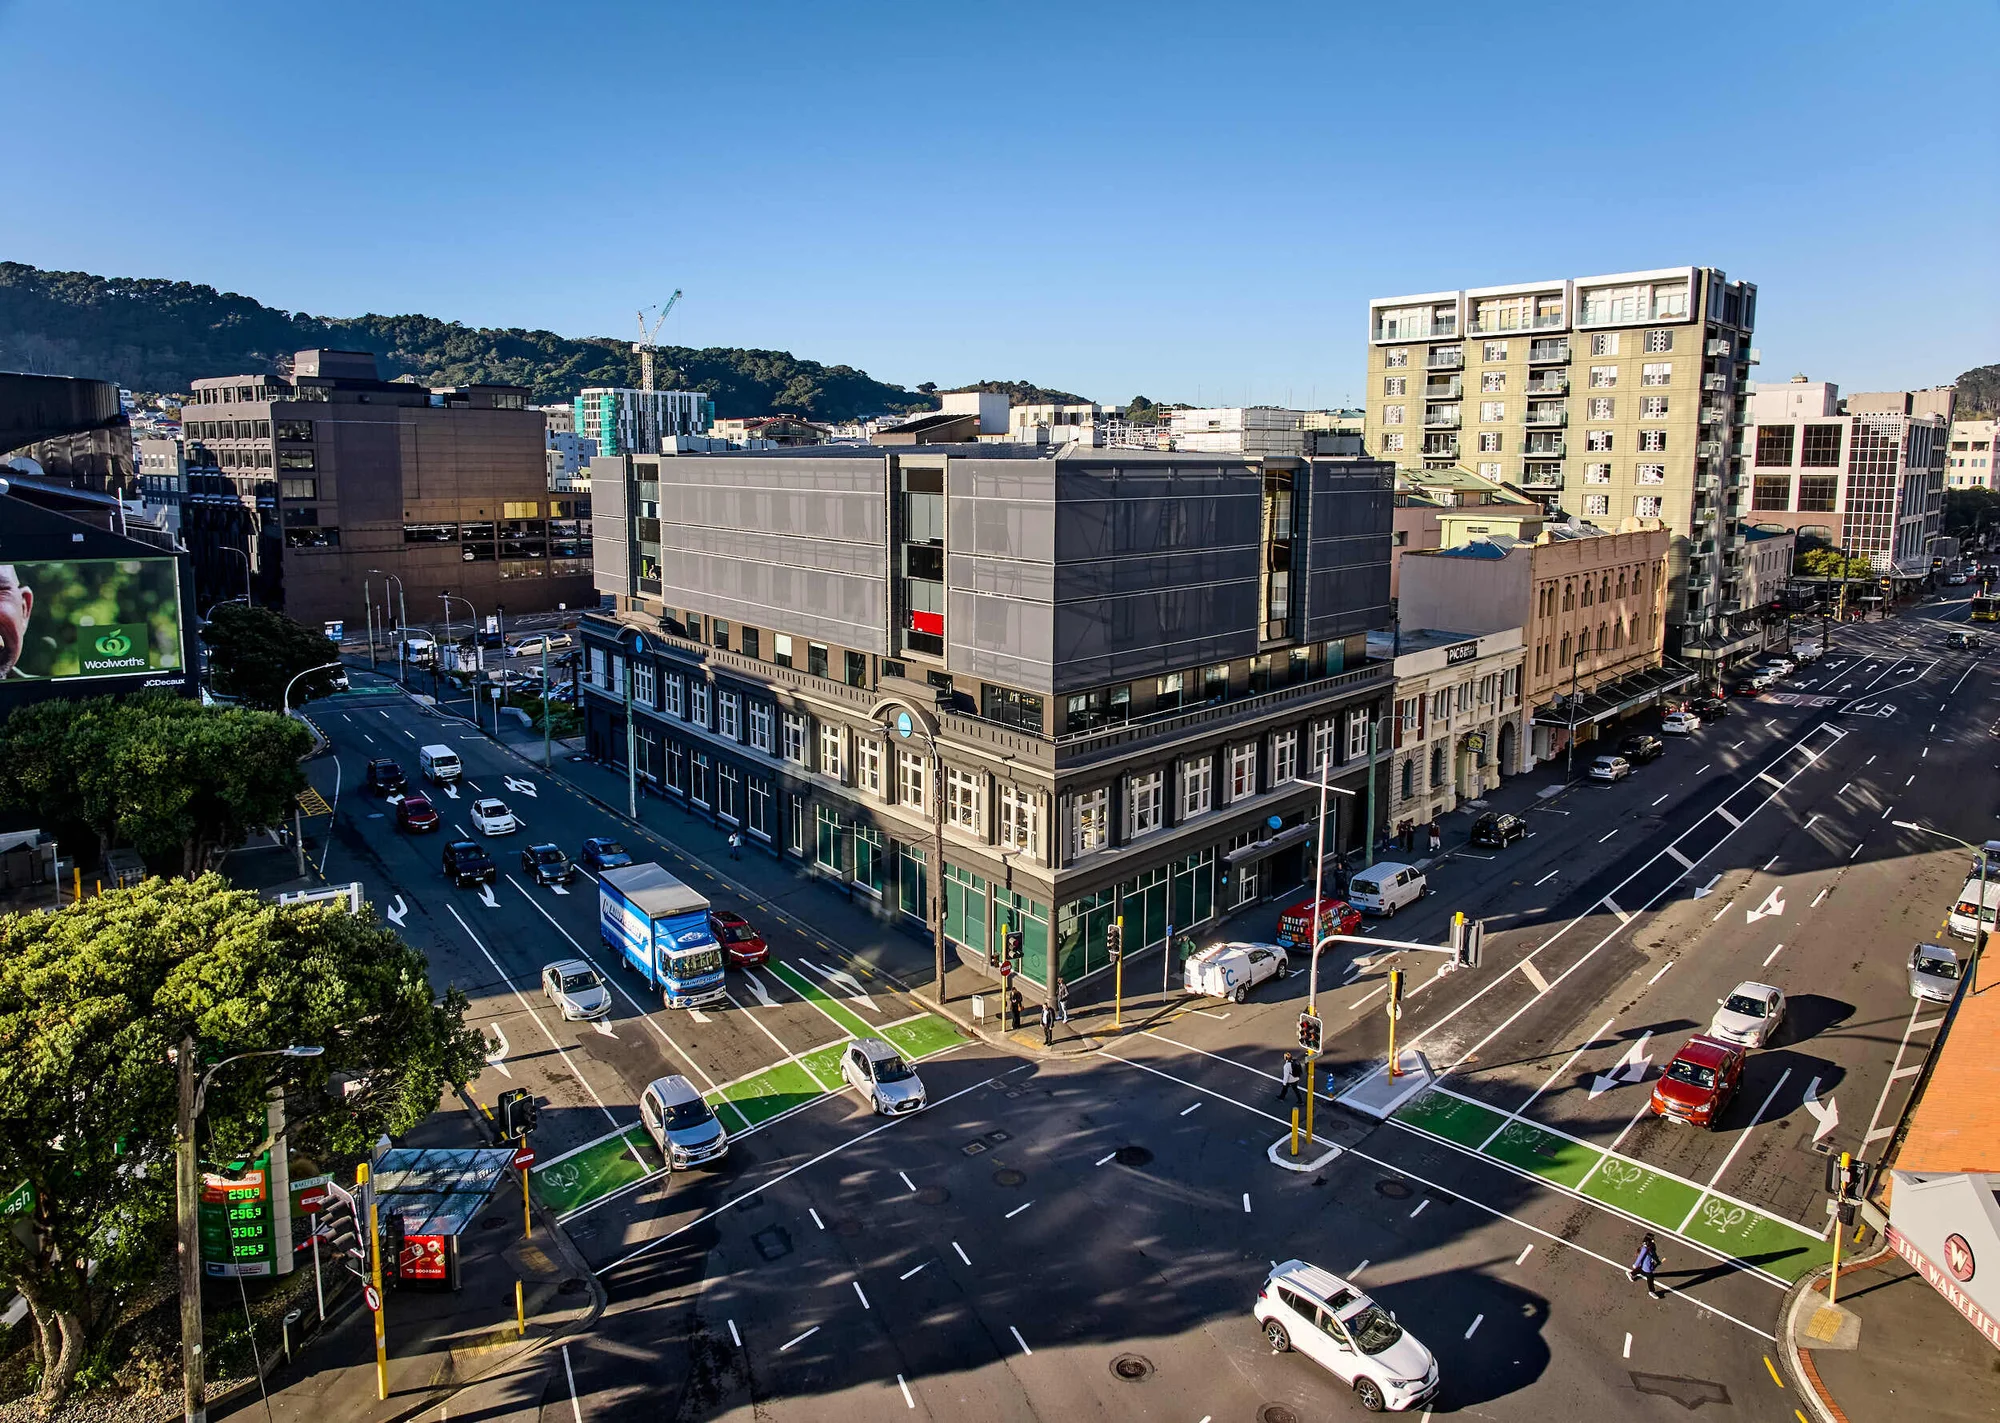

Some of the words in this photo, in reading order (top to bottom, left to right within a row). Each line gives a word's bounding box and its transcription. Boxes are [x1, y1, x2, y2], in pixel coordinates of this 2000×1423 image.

[84, 657, 145, 669] Woolworths
[144, 679, 185, 687] JCDecaux
[680, 976, 720, 986] MAINFEIGHT
[228, 1187, 260, 1200] 290.9
[230, 1207, 261, 1220] 296.9
[231, 1225, 263, 1239] 330.9
[233, 1244, 264, 1257] 225.9
[1898, 1236, 1927, 1274] THE
[1950, 1240, 1968, 1274] W
